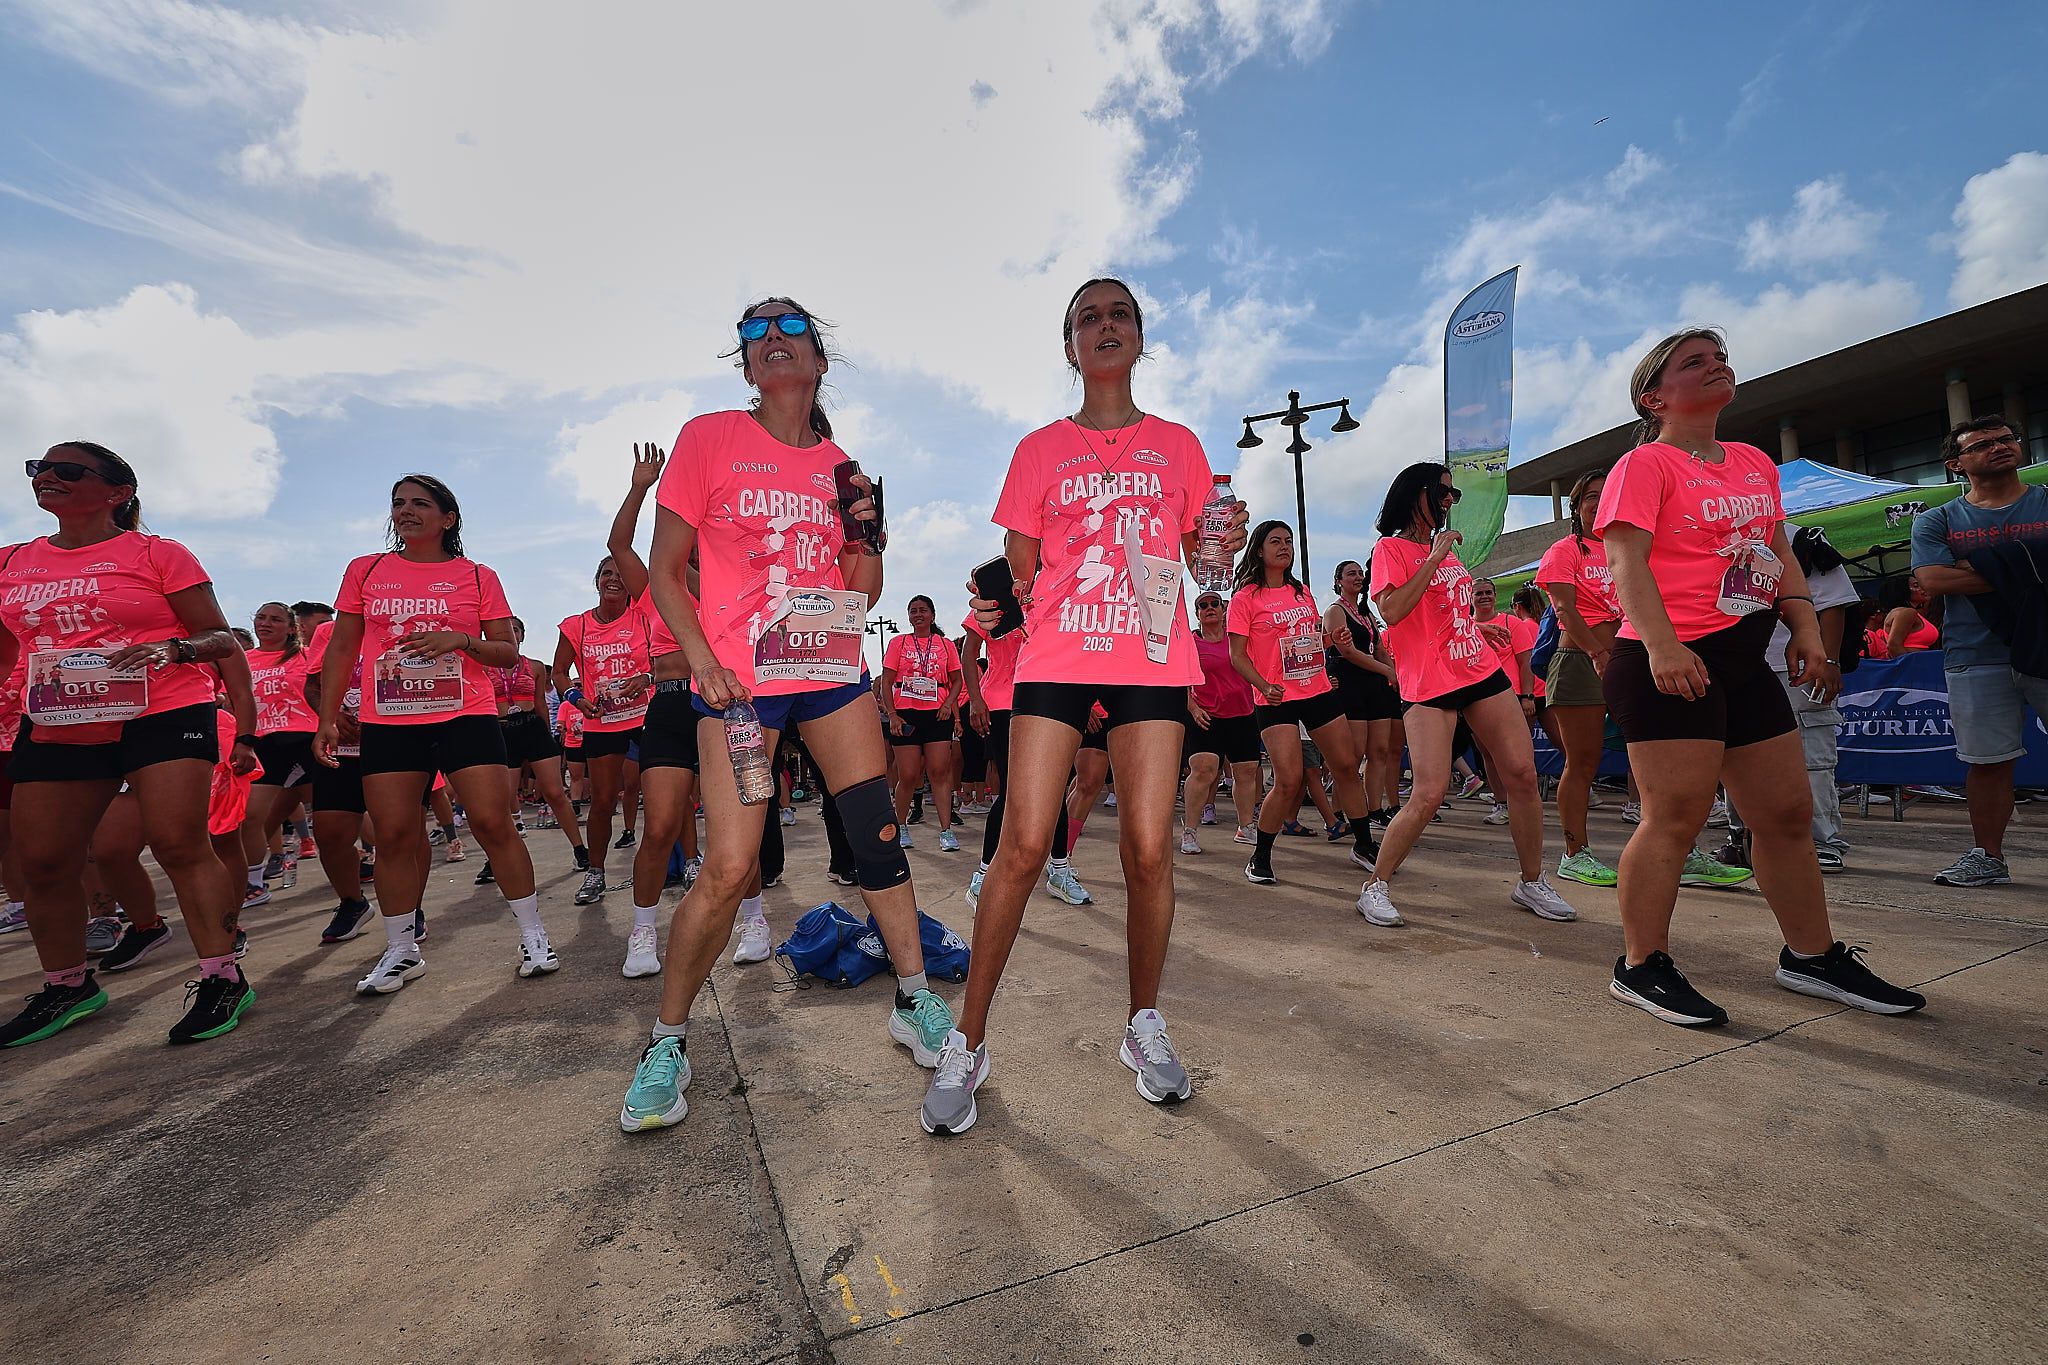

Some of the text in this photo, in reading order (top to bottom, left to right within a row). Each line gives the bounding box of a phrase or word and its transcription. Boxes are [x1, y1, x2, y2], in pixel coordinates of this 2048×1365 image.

[732, 462, 778, 473] OYSHO
[1056, 453, 1097, 472] OYSHO
[1060, 472, 1163, 506] CARRERA
[1752, 573, 1774, 591] 016
[4, 578, 101, 606] CARRERA
[371, 598, 450, 615] CARRERA
[792, 602, 831, 611] ASTURIANA
[1058, 603, 1141, 635] MUJER
[789, 632, 828, 648] 016
[1083, 636, 1113, 652] 2026
[583, 642, 632, 657] CARRERA
[799, 649, 817, 657] 1770
[63, 659, 108, 668] ASTURIANA
[825, 657, 849, 665] VALENCIA
[1297, 653, 1313, 663] 016
[251, 666, 286, 680] RRERA
[763, 667, 848, 677] OYSHO Santander
[64, 681, 110, 696] 016
[402, 679, 435, 690] 016
[40, 704, 67, 712] CARRERA
[1842, 708, 1945, 718] ENTRAL LECH
[43, 712, 82, 722] OYSHO
